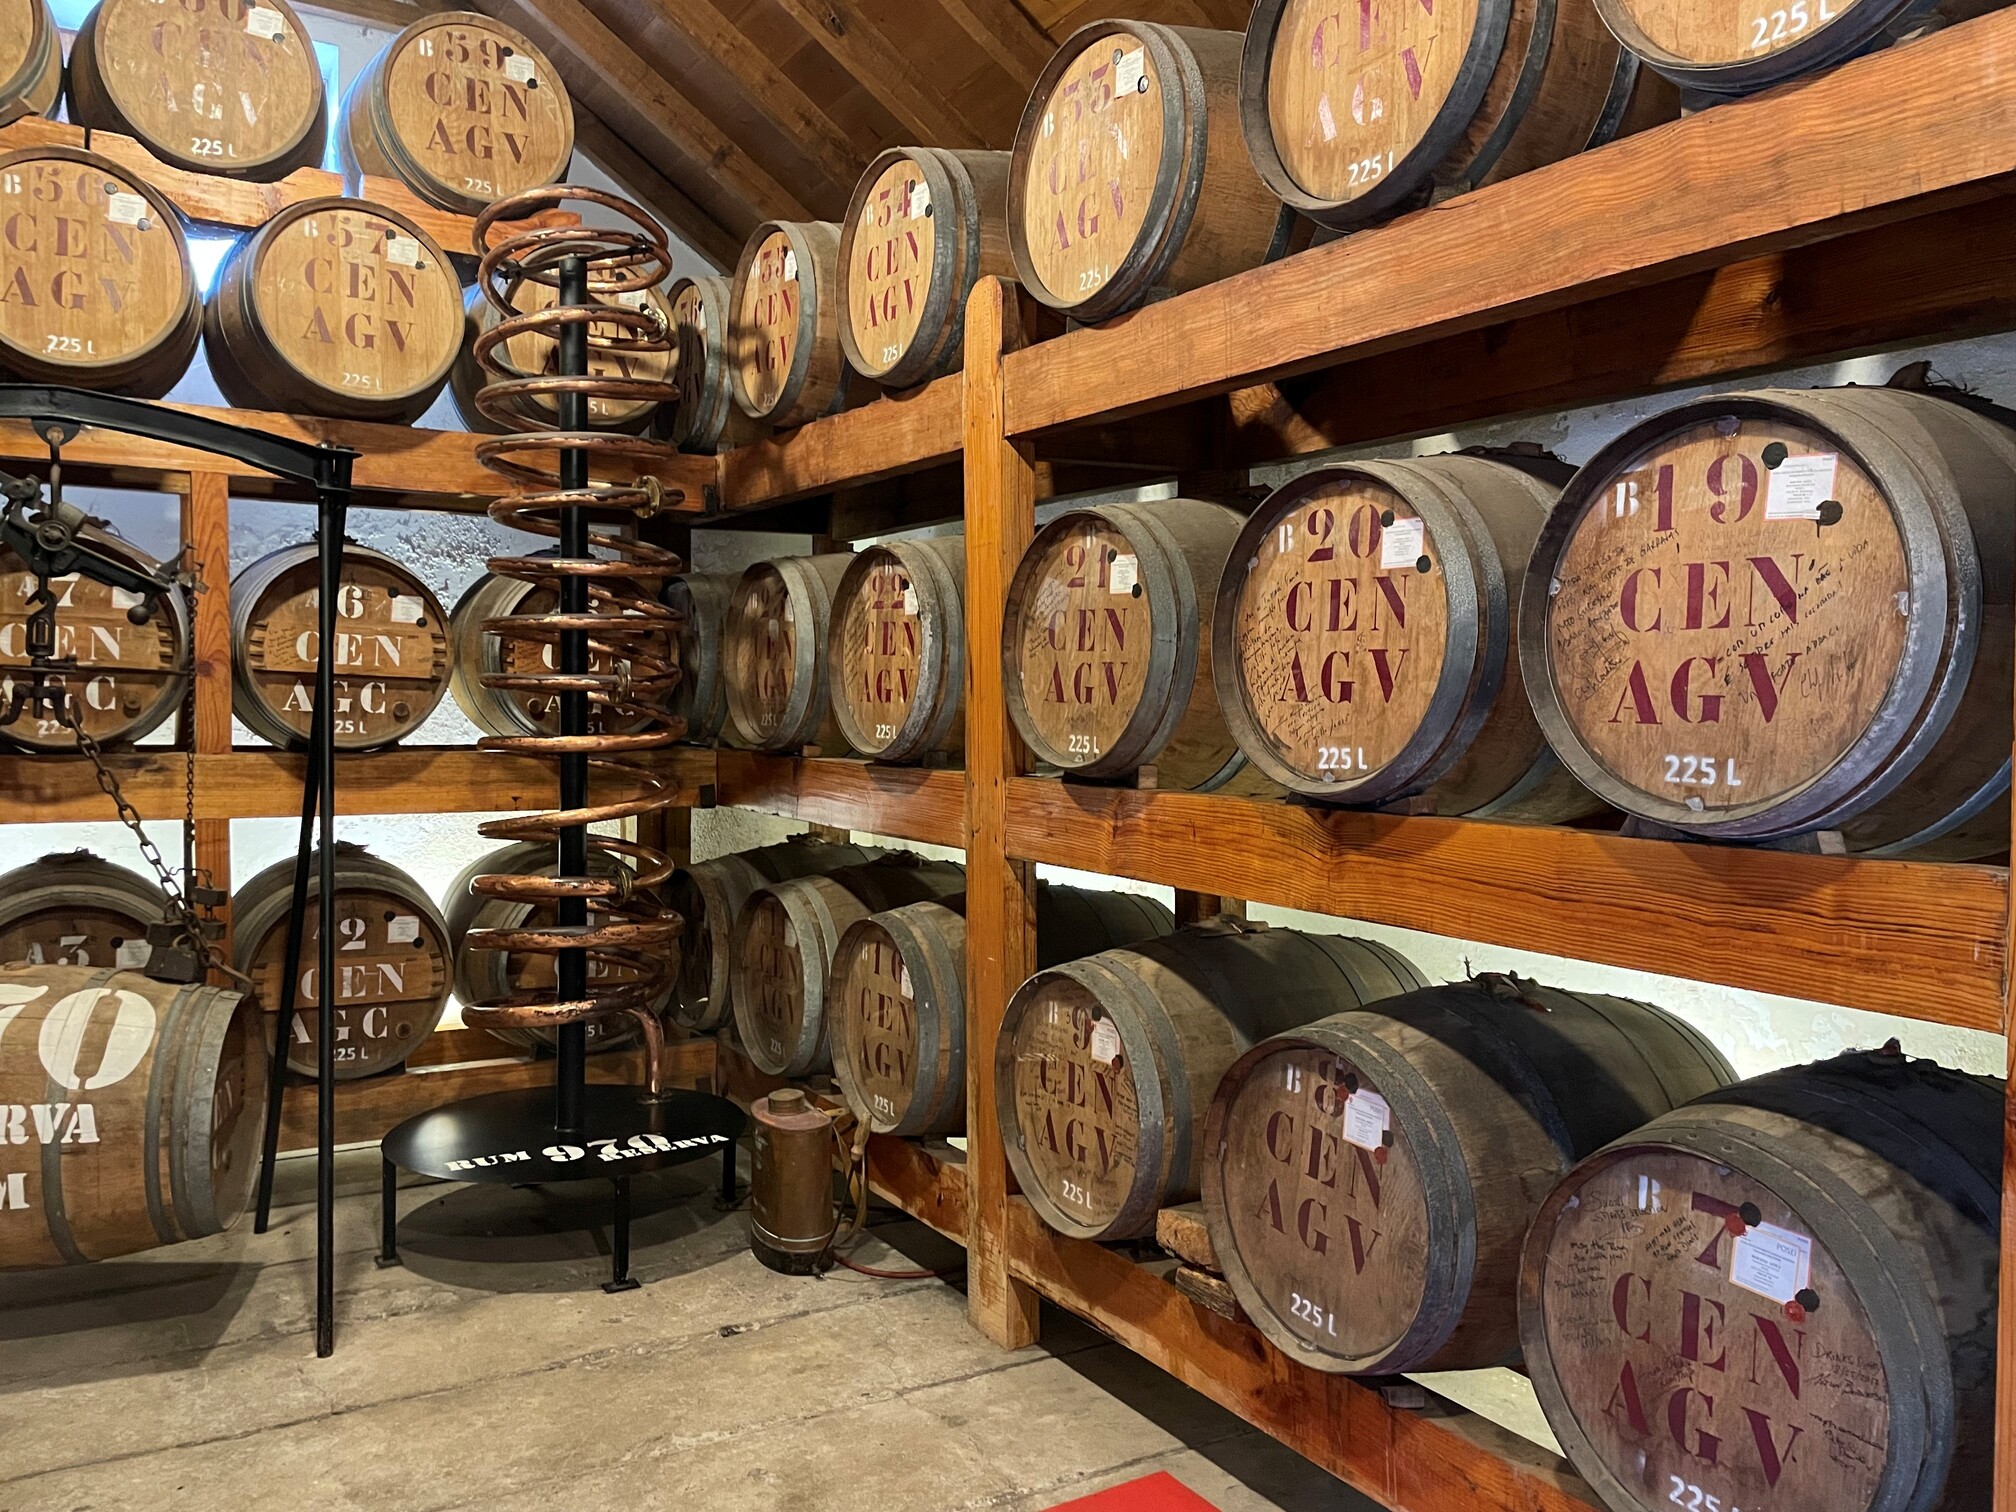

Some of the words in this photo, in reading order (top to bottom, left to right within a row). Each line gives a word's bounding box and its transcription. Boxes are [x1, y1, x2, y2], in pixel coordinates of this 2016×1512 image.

[1750, 5, 1808, 49] 225
[1818, 0, 1836, 22] L
[419, 38, 434, 57] B
[445, 30, 505, 71] 59
[425, 71, 529, 122] CEN
[1305, 35, 1438, 149] AGV
[426, 117, 531, 165] AGV
[1043, 112, 1055, 137] B
[190, 138, 223, 157] 225
[228, 144, 238, 157] L
[4, 173, 22, 195] B
[33, 166, 105, 207] 56
[464, 177, 492, 194] 225
[497, 183, 504, 196] L
[1348, 155, 1382, 186] 225
[866, 204, 874, 225] B
[1048, 177, 1129, 257] AGV
[4, 212, 136, 266] CEN
[303, 219, 319, 238] B
[327, 214, 390, 256] 57
[867, 226, 920, 283] CEN
[0, 266, 135, 314] AGV
[304, 256, 417, 310] CEN
[1079, 270, 1101, 292] 225
[1104, 265, 1110, 282] L
[754, 289, 793, 329] CEN
[864, 275, 920, 330] AGV
[46, 334, 82, 353] 225
[87, 340, 97, 355] L
[301, 305, 417, 353] AGV
[751, 334, 792, 375] AGV
[882, 345, 898, 363] 225
[341, 373, 371, 389] 225
[376, 377, 383, 391] L
[763, 393, 774, 406] 225
[1616, 481, 1638, 517] B
[1653, 453, 1758, 532] 19
[1279, 524, 1293, 553] B
[1307, 504, 1382, 563] 20
[1066, 544, 1108, 588] 21
[51, 572, 81, 607] 7
[336, 585, 364, 619] 6
[871, 573, 904, 610] 22
[1285, 574, 1410, 633] CEN
[1619, 553, 1804, 633] CEN
[296, 630, 403, 667] CEN
[755, 630, 792, 660] CEN
[864, 621, 917, 657] CEN
[1049, 608, 1128, 652] CEN
[861, 668, 914, 704] AGV
[1045, 661, 1128, 705] AGV
[1278, 648, 1411, 704] AGV
[1608, 652, 1804, 726] AGV
[282, 679, 386, 714] AGC
[334, 720, 355, 734] 25
[359, 720, 367, 734] L
[761, 713, 772, 727] 225
[876, 724, 891, 739] 225
[1068, 734, 1091, 753] 225
[1094, 736, 1100, 754] L
[1318, 747, 1351, 770] 225
[1357, 748, 1368, 770] L
[1664, 755, 1717, 785] 225
[1726, 758, 1741, 786] L
[340, 918, 366, 950] 2
[301, 963, 406, 999] CEN
[861, 986, 916, 1041] CEN
[1049, 1001, 1058, 1024] B
[1072, 1006, 1092, 1050] 9
[361, 1046, 369, 1060] L
[770, 1038, 782, 1054] 225
[862, 1034, 912, 1086] AGV
[874, 1094, 888, 1112] 225
[890, 1101, 895, 1117] L
[1039, 1060, 1115, 1120] CEN
[1286, 1063, 1301, 1093] B
[1315, 1060, 1345, 1118] 8
[444, 1150, 532, 1172] RUM
[542, 1134, 668, 1162] 970
[597, 1135, 730, 1162] RESERVA
[1039, 1108, 1118, 1176] AGV
[1266, 1110, 1383, 1210] CEN
[1062, 1180, 1084, 1205] 225
[1086, 1193, 1094, 1210] L
[1254, 1178, 1382, 1276] AGV
[1638, 1174, 1661, 1211] B
[1691, 1191, 1742, 1271] 7
[1776, 1243, 1797, 1256] POSEI
[1290, 1293, 1323, 1327] 225
[1328, 1314, 1337, 1337] L
[1612, 1272, 1807, 1401] CEN
[1601, 1360, 1805, 1489] AGV
[1669, 1475, 1720, 1512] 225
